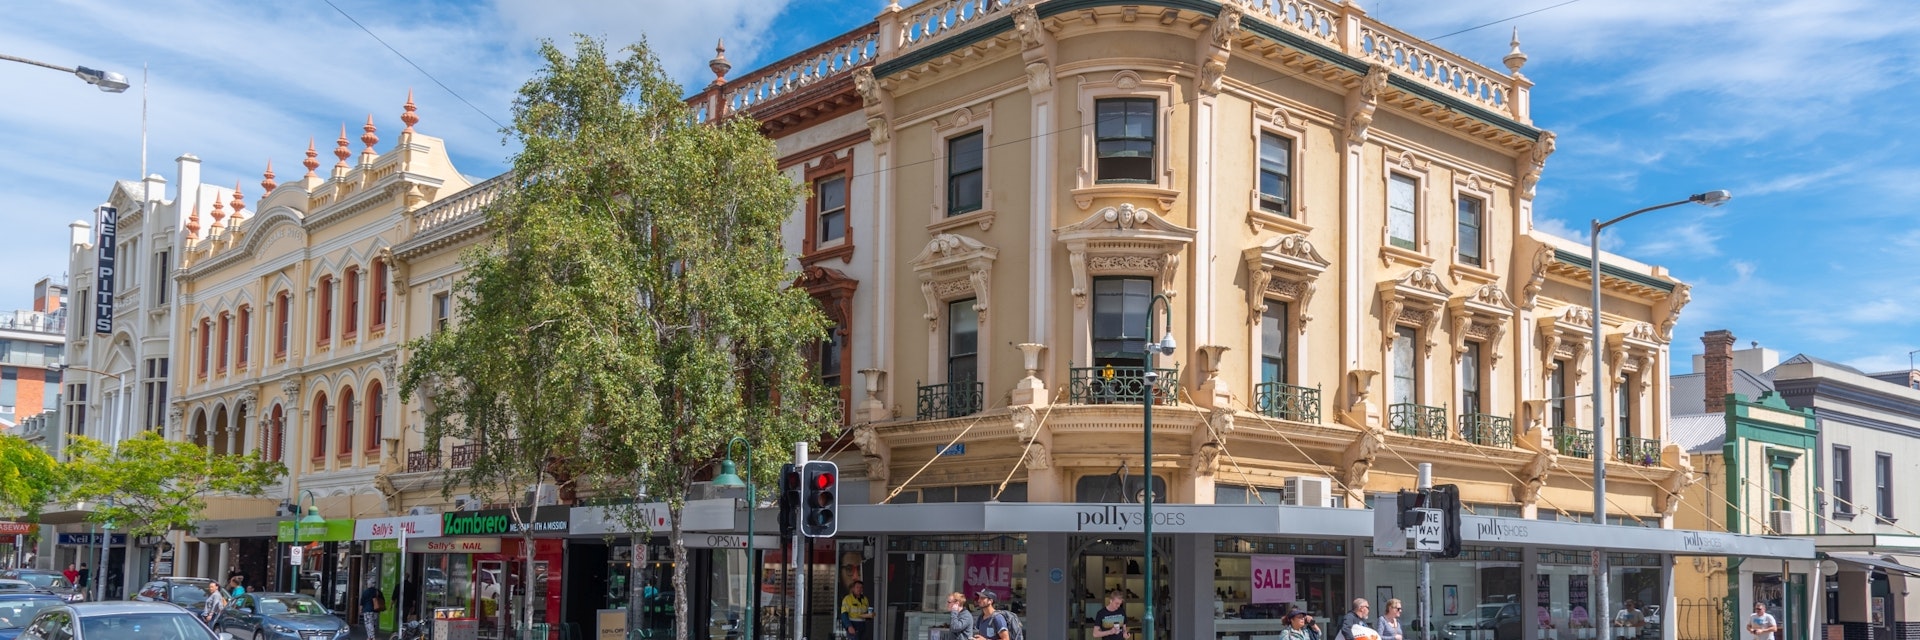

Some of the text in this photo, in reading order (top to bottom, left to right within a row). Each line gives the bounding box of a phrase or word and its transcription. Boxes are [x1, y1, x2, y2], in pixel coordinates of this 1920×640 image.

[96, 210, 115, 332] NEIL PITT'S
[371, 522, 393, 538] Sally's
[444, 512, 507, 534] Zambrero
[1418, 526, 1439, 535] WAY
[68, 534, 118, 544] Neil Pi's
[427, 541, 482, 551] Sally's NAIL
[706, 534, 740, 547] OPSM
[967, 566, 1009, 587] SALE
[1254, 568, 1291, 589] SALE
